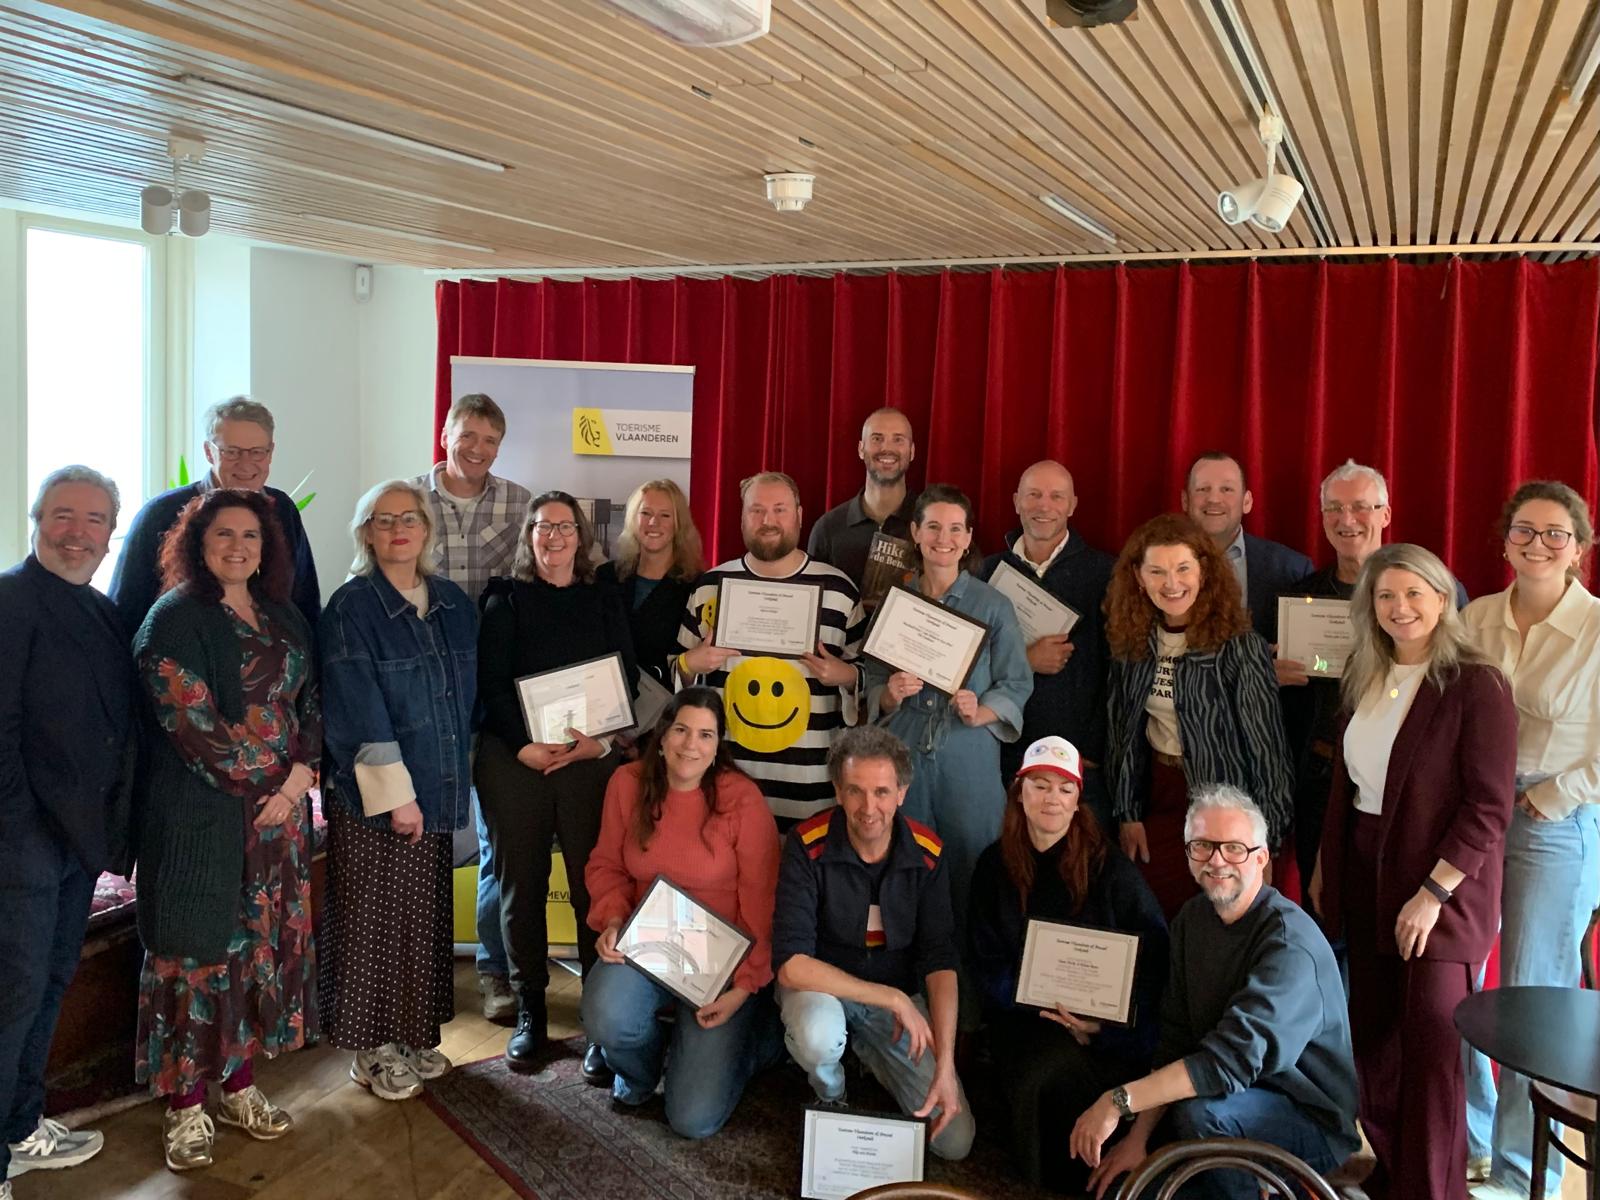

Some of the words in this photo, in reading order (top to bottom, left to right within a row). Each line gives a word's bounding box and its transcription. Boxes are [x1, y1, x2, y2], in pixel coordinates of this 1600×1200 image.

[615, 422, 661, 433] TOERISME
[615, 432, 679, 443] VLAANDEREN
[873, 551, 885, 563] de
[886, 555, 906, 569] Ben
